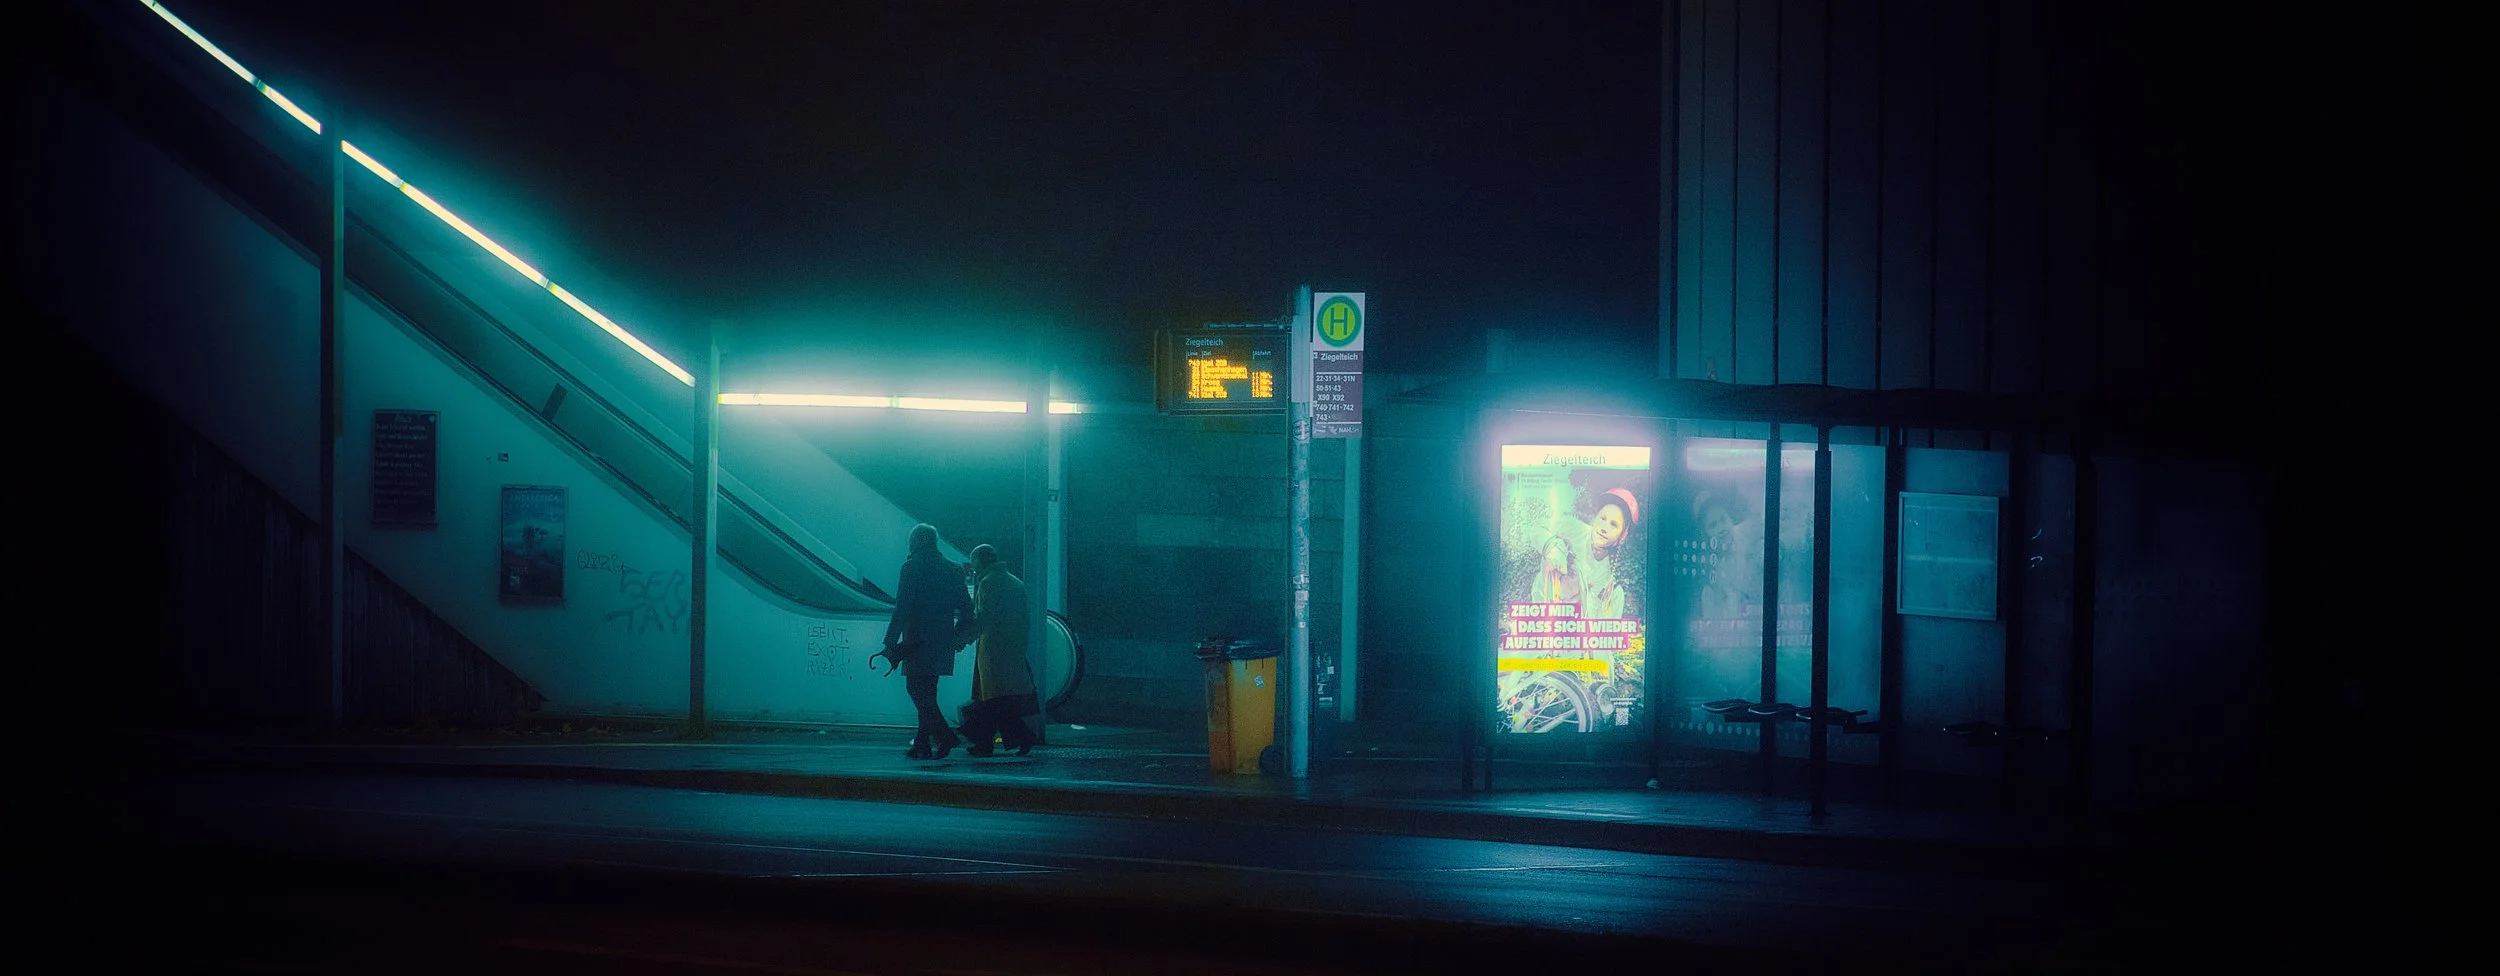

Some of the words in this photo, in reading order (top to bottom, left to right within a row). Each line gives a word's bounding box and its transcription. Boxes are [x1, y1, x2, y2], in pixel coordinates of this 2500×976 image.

[1185, 337, 1224, 347] Ziegelteich
[1320, 353, 1358, 362] Ziegelteich
[1543, 453, 1606, 467] Ziegelteich
[1511, 604, 1546, 617] ZEIGT
[1548, 604, 1579, 619] MIR,
[1518, 621, 1552, 633] DASS
[1554, 621, 1586, 633] SICH
[1588, 621, 1637, 633] WIEDER
[1505, 636, 1580, 649] AUFSTEIGEN
[1583, 636, 1627, 649] LOHNT.
